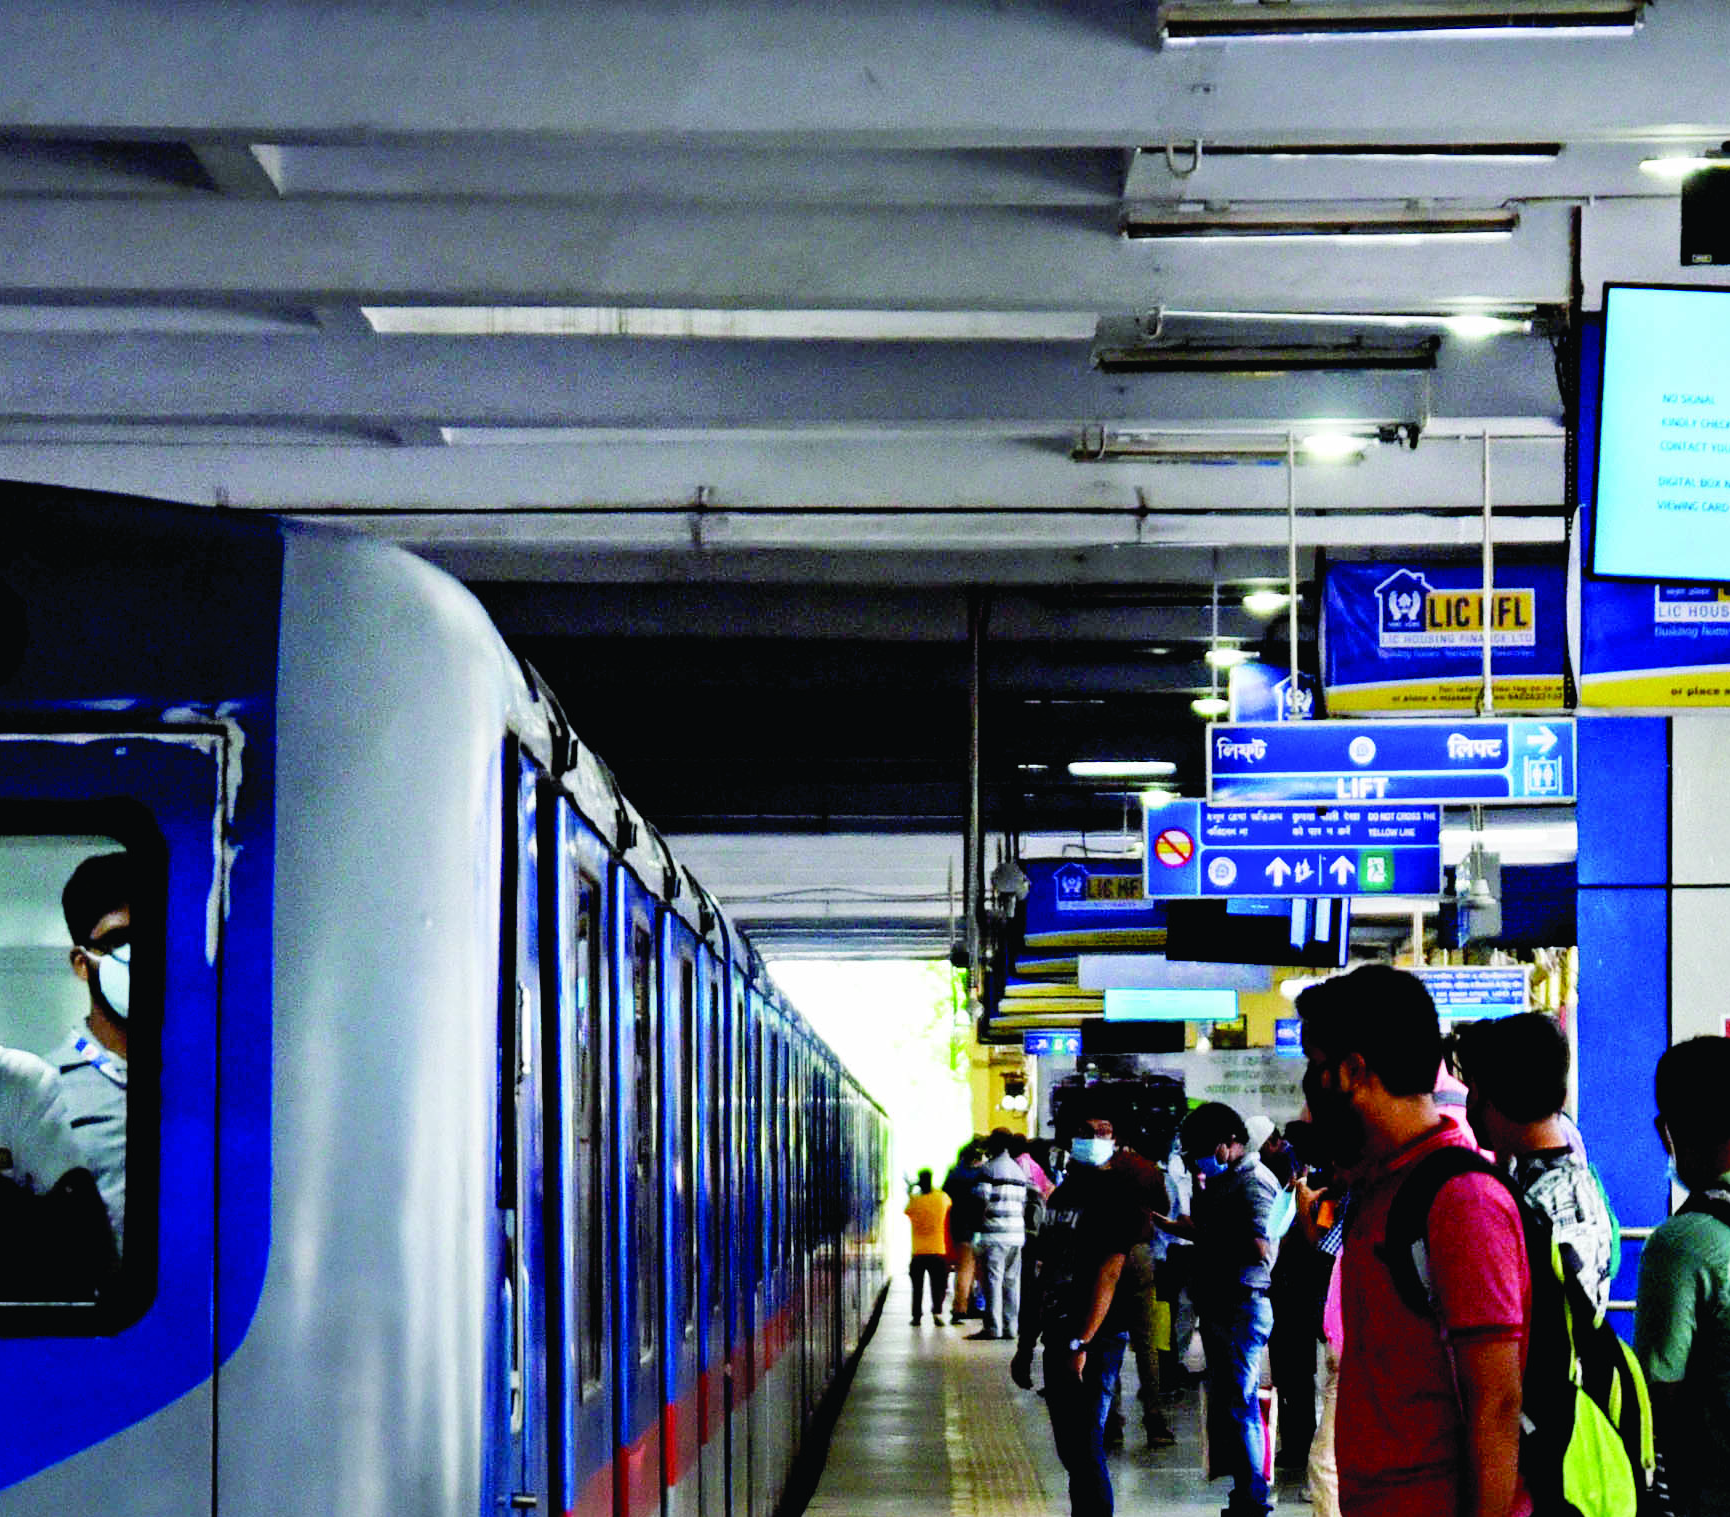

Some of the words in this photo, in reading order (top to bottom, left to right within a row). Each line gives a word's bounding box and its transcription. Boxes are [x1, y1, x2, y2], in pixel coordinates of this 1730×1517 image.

[1660, 440, 1707, 451] CONTACT
[1702, 501, 1728, 513] CARD
[1429, 597, 1469, 627] LIC
[1658, 605, 1682, 617] LIC
[1336, 777, 1389, 799] LIFT
